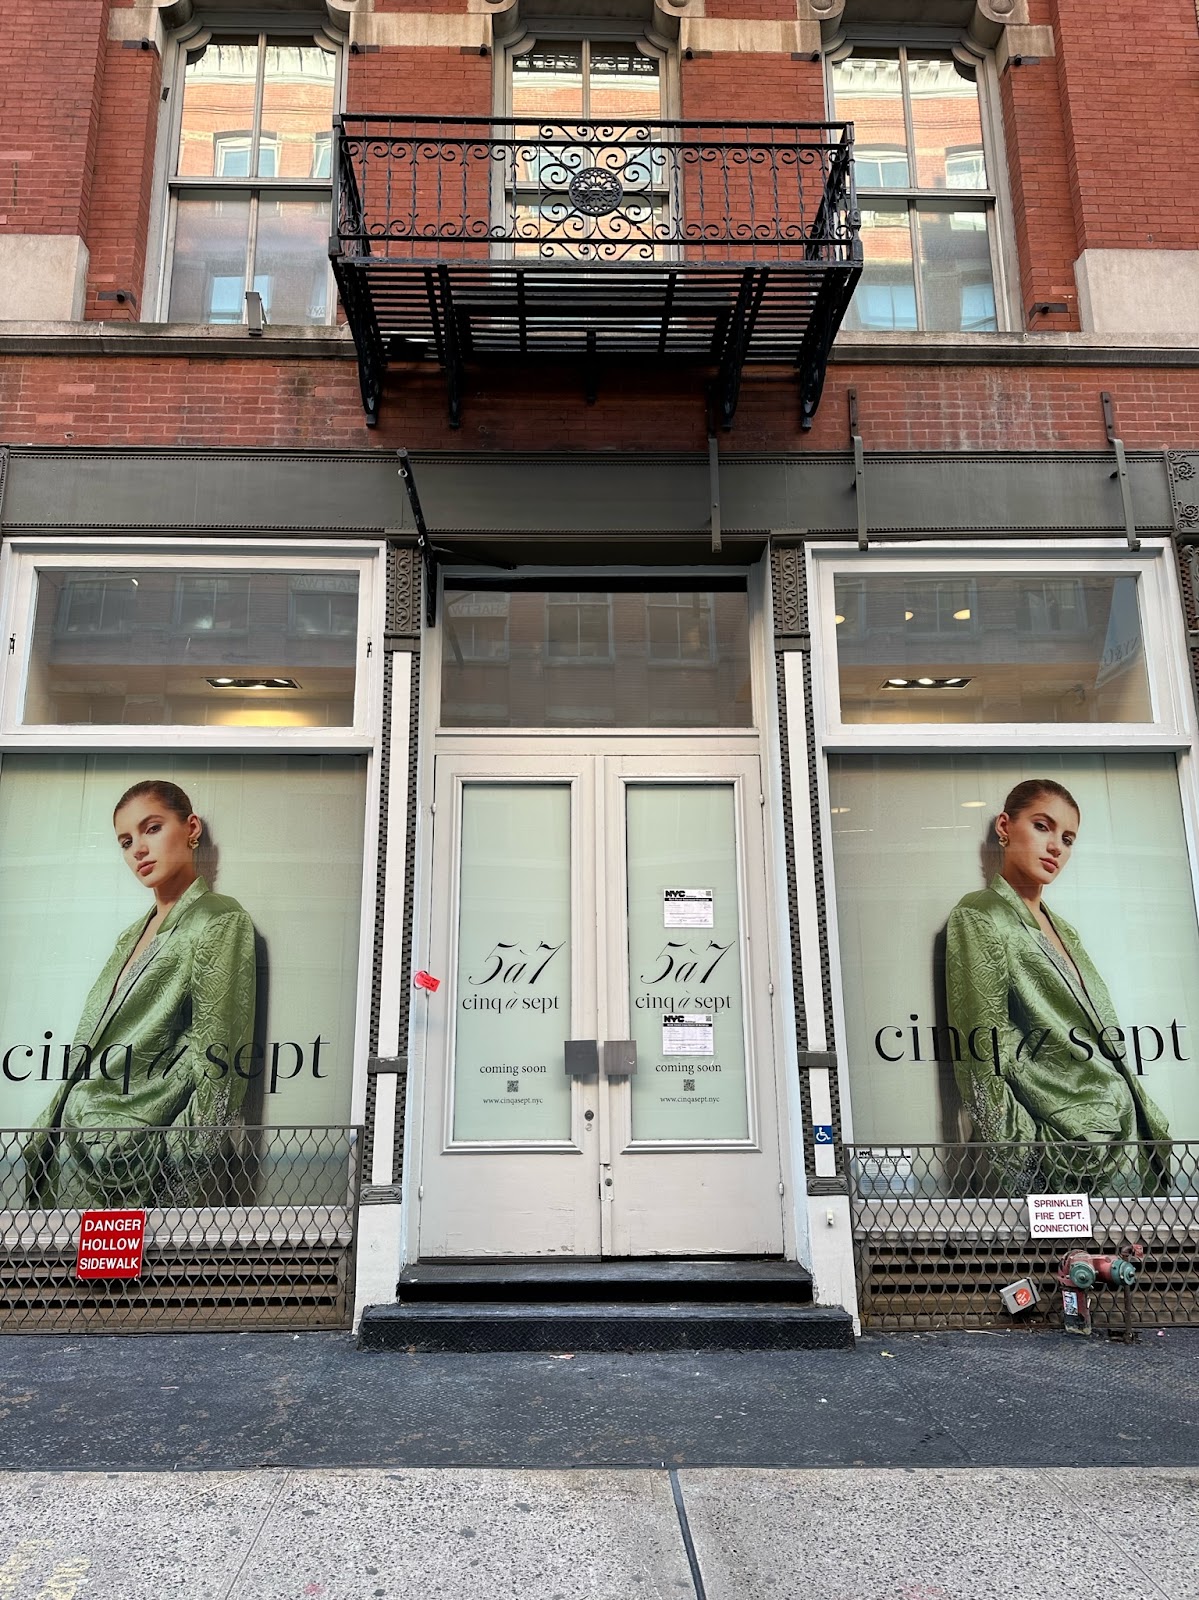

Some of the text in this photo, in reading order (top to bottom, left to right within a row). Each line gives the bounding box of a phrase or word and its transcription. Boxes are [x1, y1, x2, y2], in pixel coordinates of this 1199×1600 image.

[665, 890, 686, 898] NYC
[462, 993, 502, 1014] cinq
[522, 995, 560, 1014] sept
[635, 992, 675, 1013] cinq
[694, 994, 733, 1013] sept
[664, 1015, 685, 1023] NYC
[874, 1013, 1006, 1077] cinq
[1069, 1017, 1191, 1076] sept
[2, 1030, 135, 1096] cinq
[203, 1033, 331, 1095] sept
[479, 1063, 547, 1077] coming soon
[655, 1062, 722, 1076] coming soon
[1033, 1199, 1084, 1208] SPRINKLER
[1034, 1211, 1085, 1220] FIRE DEPT.
[84, 1218, 142, 1232] DANGER
[1033, 1223, 1089, 1233] CONNECTION
[81, 1237, 141, 1251] HOLLOW
[79, 1257, 139, 1270] SIDEWALK
